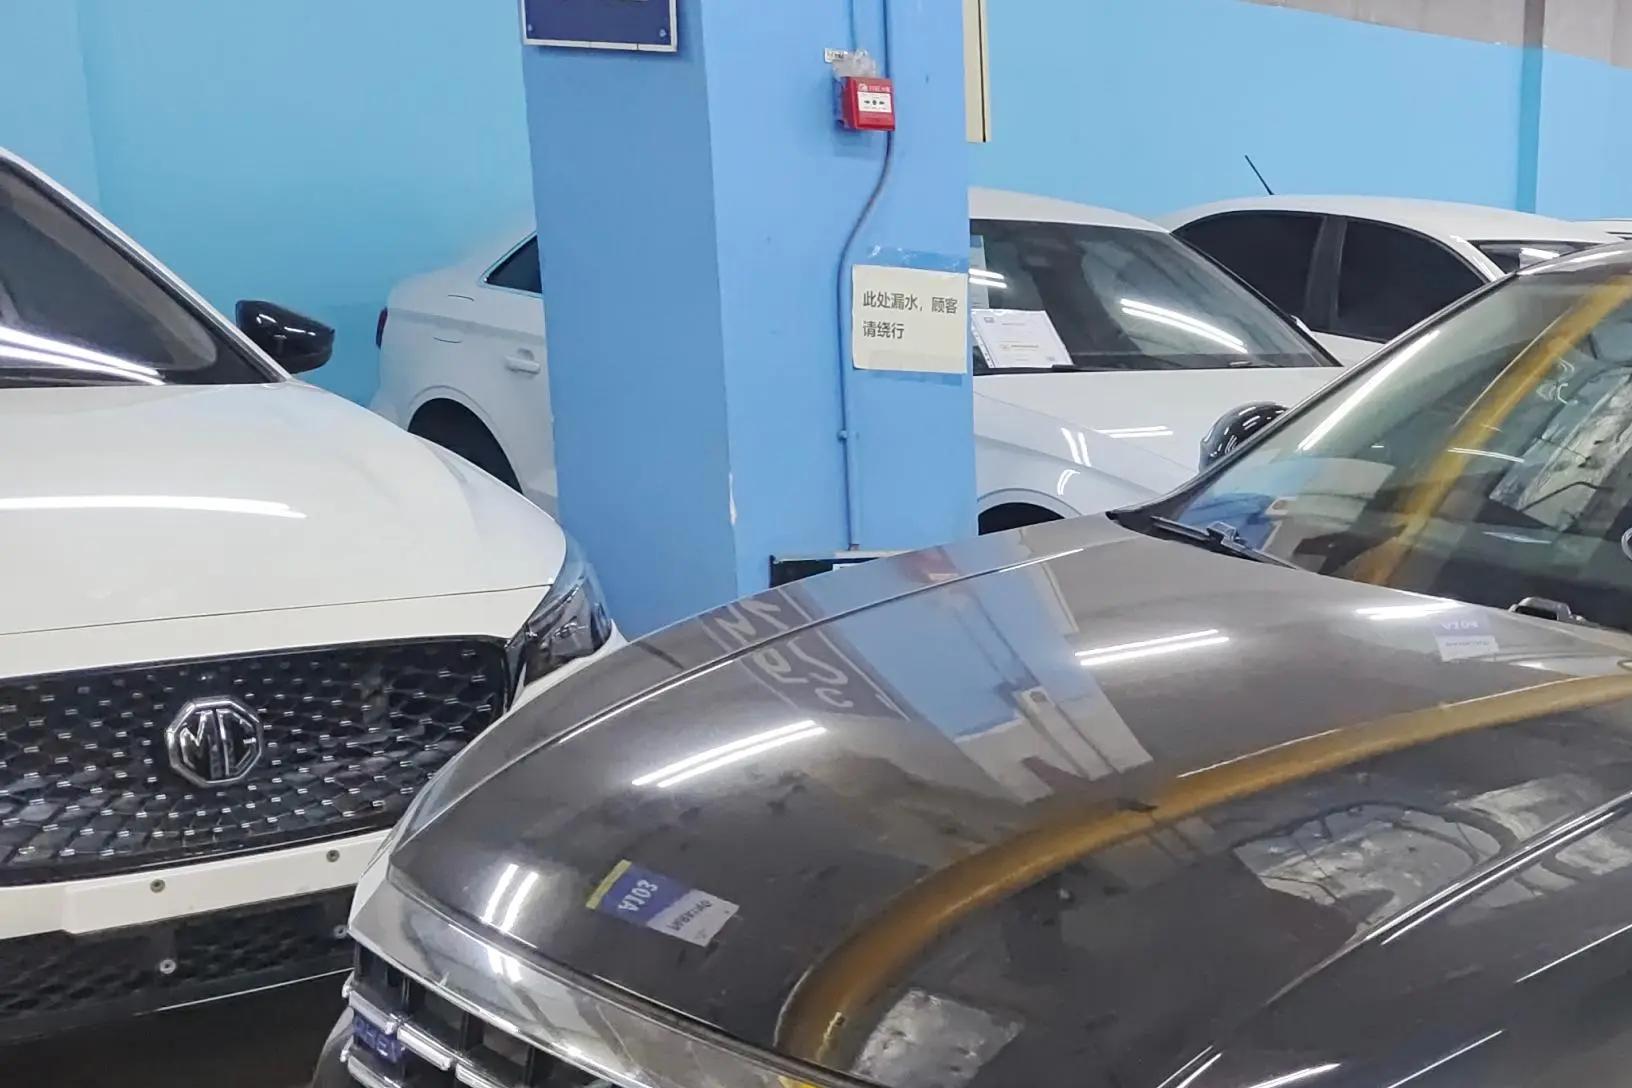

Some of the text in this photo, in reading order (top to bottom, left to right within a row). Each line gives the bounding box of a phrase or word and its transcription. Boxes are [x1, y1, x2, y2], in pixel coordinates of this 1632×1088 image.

[862, 290, 958, 314] 此处漏水，顾客
[862, 320, 905, 339] 请绕行
[176, 705, 260, 780] MG
